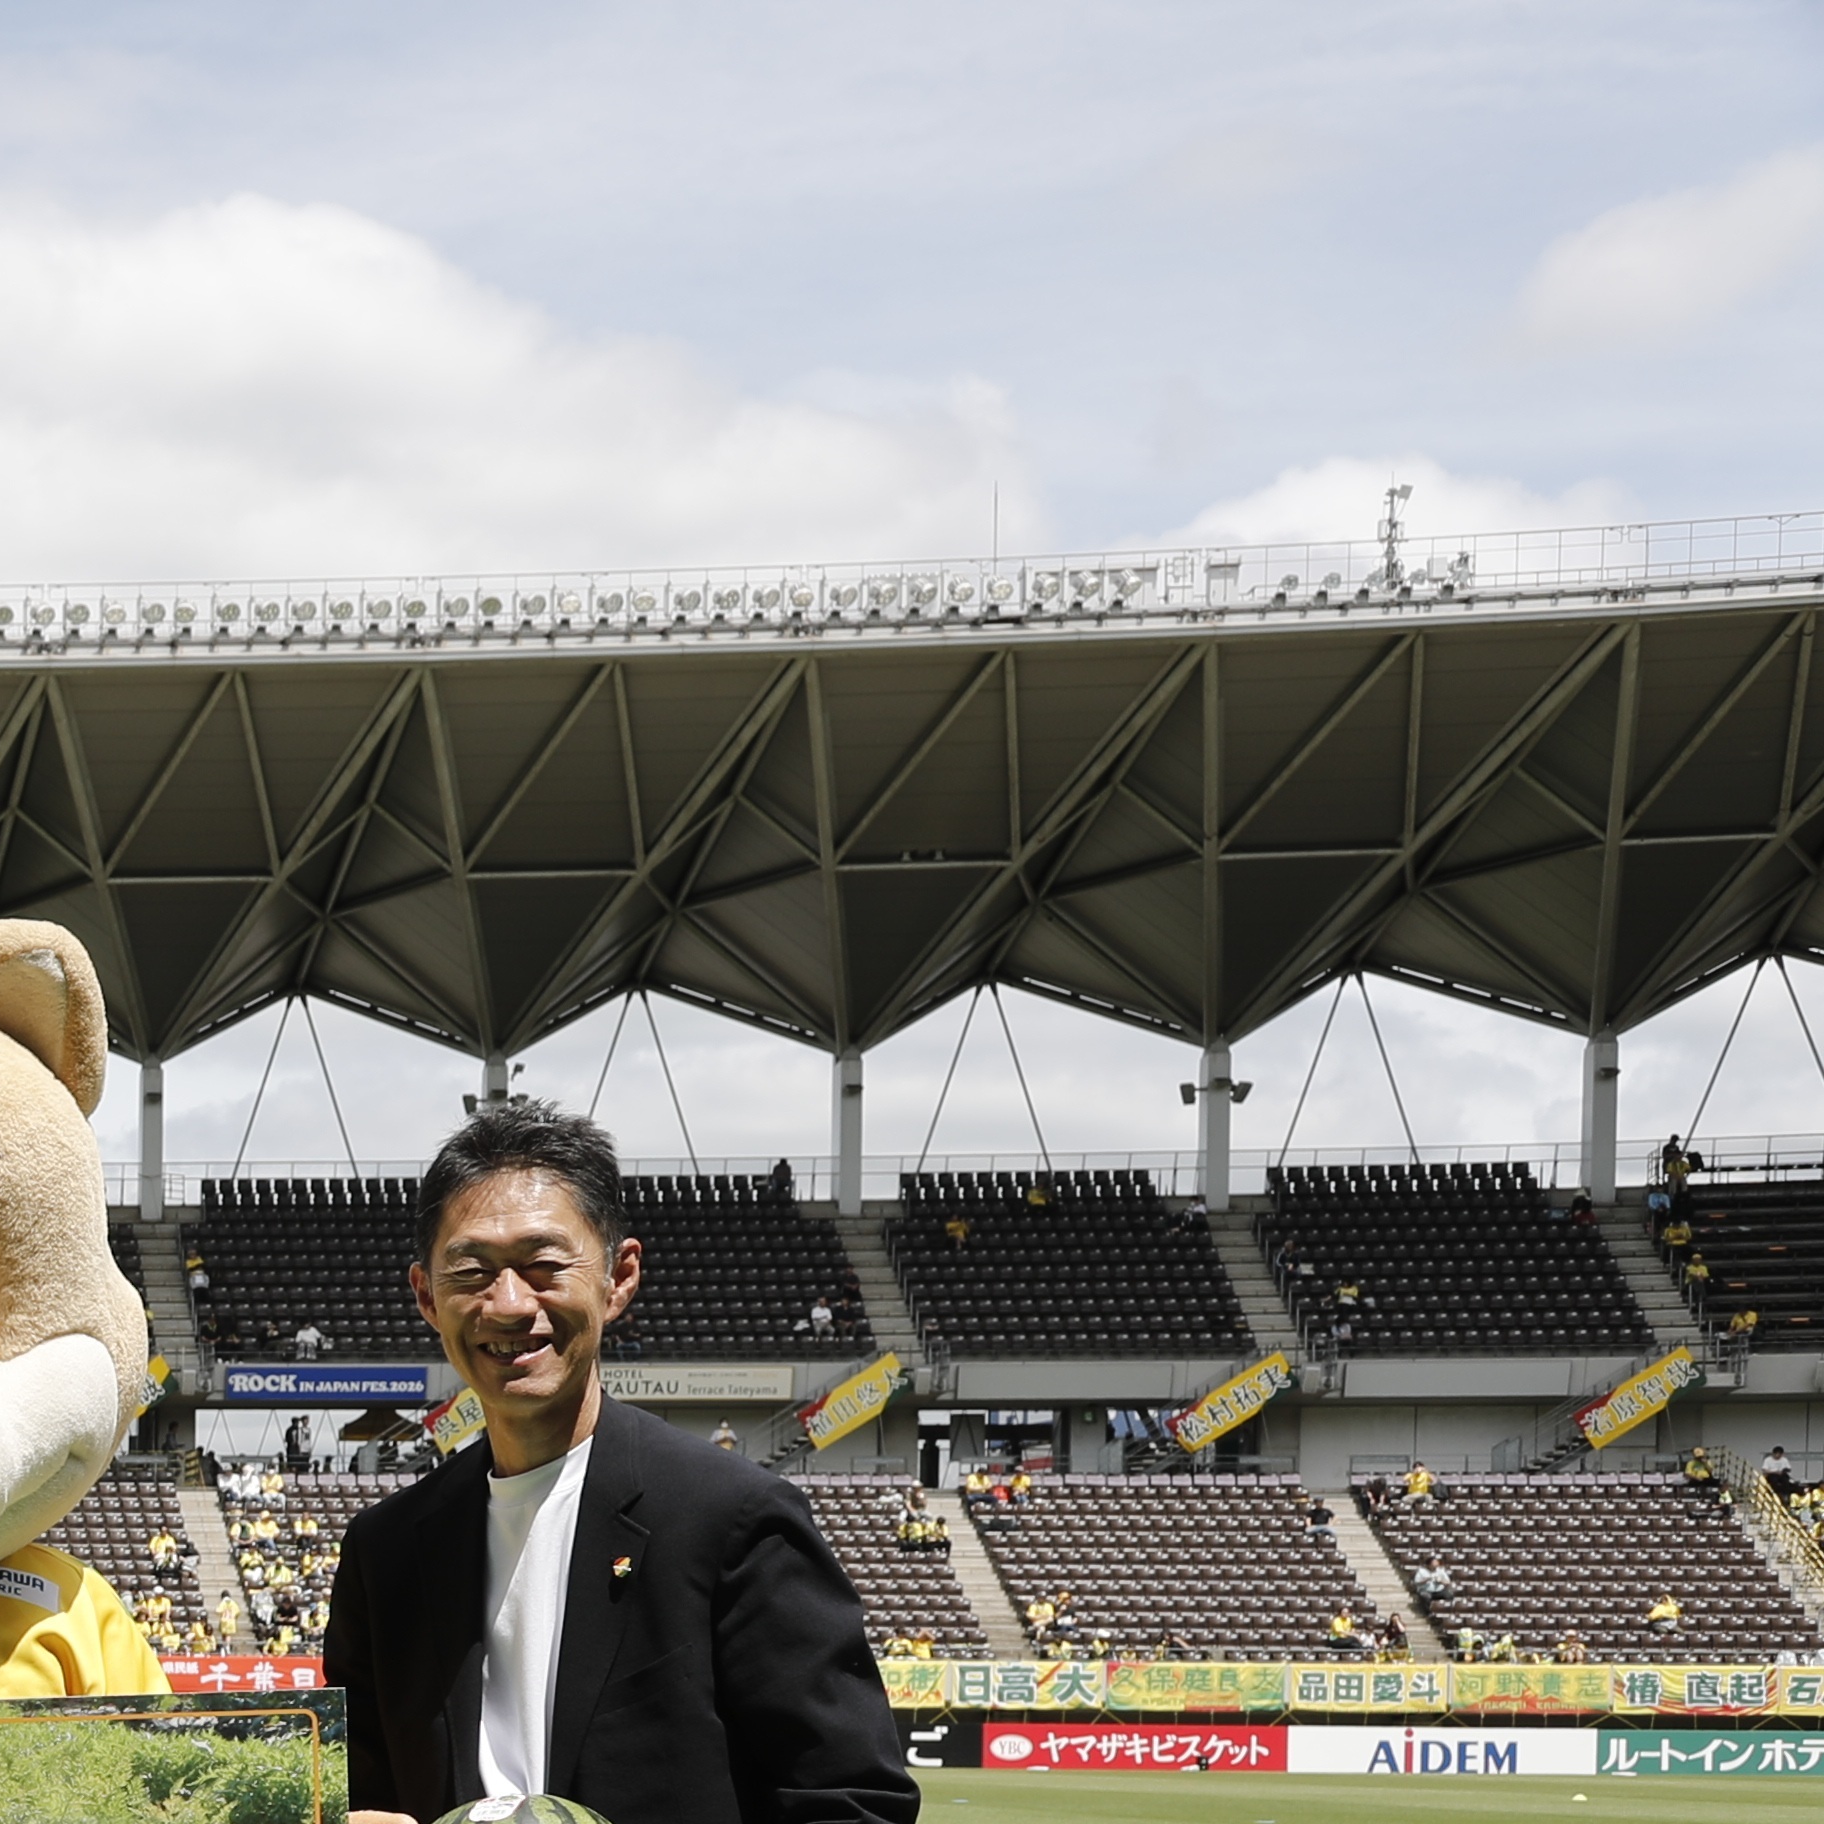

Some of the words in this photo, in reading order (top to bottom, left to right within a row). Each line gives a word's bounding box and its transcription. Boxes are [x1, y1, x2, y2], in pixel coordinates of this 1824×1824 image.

[228, 1373, 297, 1393] ROCK
[299, 1381, 313, 1393] IN
[316, 1381, 360, 1393] JAPAN
[603, 1369, 644, 1379] HOTEL
[602, 1380, 680, 1396] TAUTAU
[687, 1384, 725, 1396] Terrace
[728, 1384, 778, 1398] Tateyama
[1176, 1364, 1291, 1443] 松村拓実
[1579, 1358, 1700, 1437] 若原智哉
[1110, 1666, 1282, 1693] 久保庭良太
[1297, 1671, 1442, 1704] 品田愛斗
[1458, 1672, 1605, 1698] 河野貴志
[1788, 1675, 1824, 1706] 石
[997, 1737, 1026, 1757] YBC
[1040, 1732, 1270, 1765] ヤマザキビスケット
[1601, 1738, 1824, 1771] ルートインホテ
